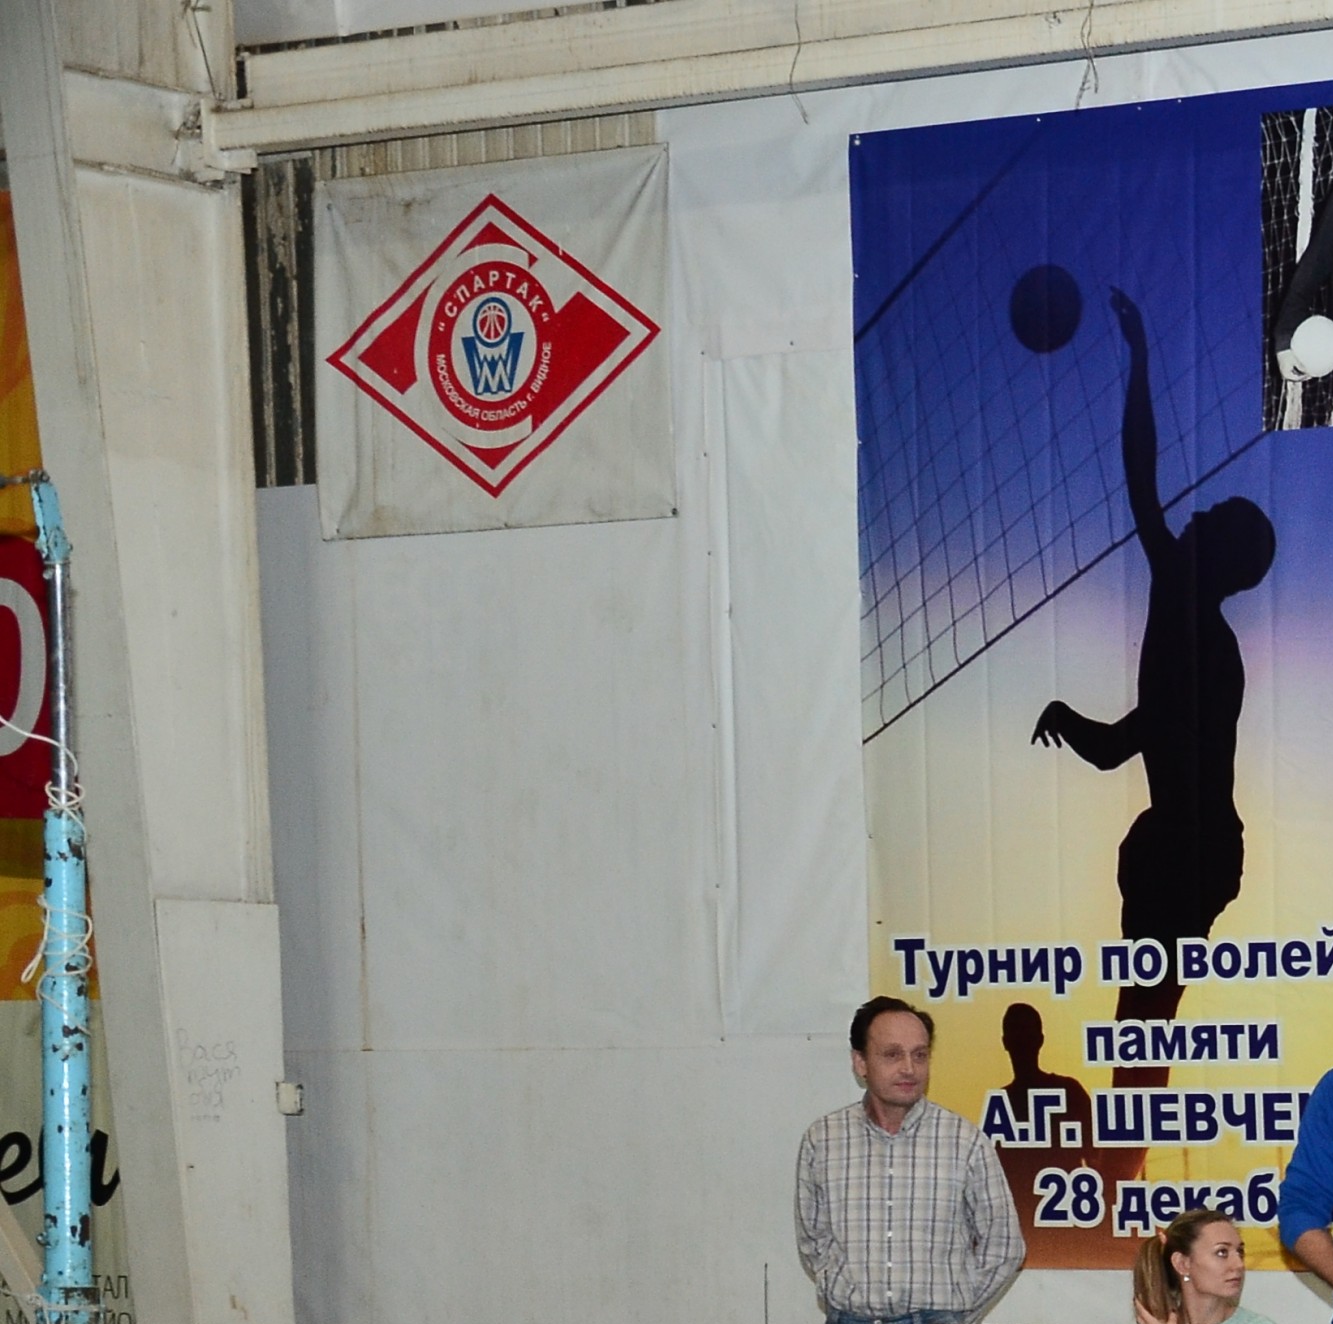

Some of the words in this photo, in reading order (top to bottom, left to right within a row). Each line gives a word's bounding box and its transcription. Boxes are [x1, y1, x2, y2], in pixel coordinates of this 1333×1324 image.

[436, 353, 480, 419] МОСКОВСКАЯ
[480, 399, 527, 421] ОБЛАСТЬ
[530, 341, 552, 394] ВИДНОЕ
[894, 937, 1082, 998] Турнир
[1101, 944, 1163, 981] по
[1086, 1024, 1279, 1062] памяти
[982, 1094, 1077, 1142] А.Г.
[1096, 1092, 1310, 1142] ШЕВЧЕ
[1038, 1173, 1100, 1222] 28
[1117, 1173, 1278, 1231] декаб
